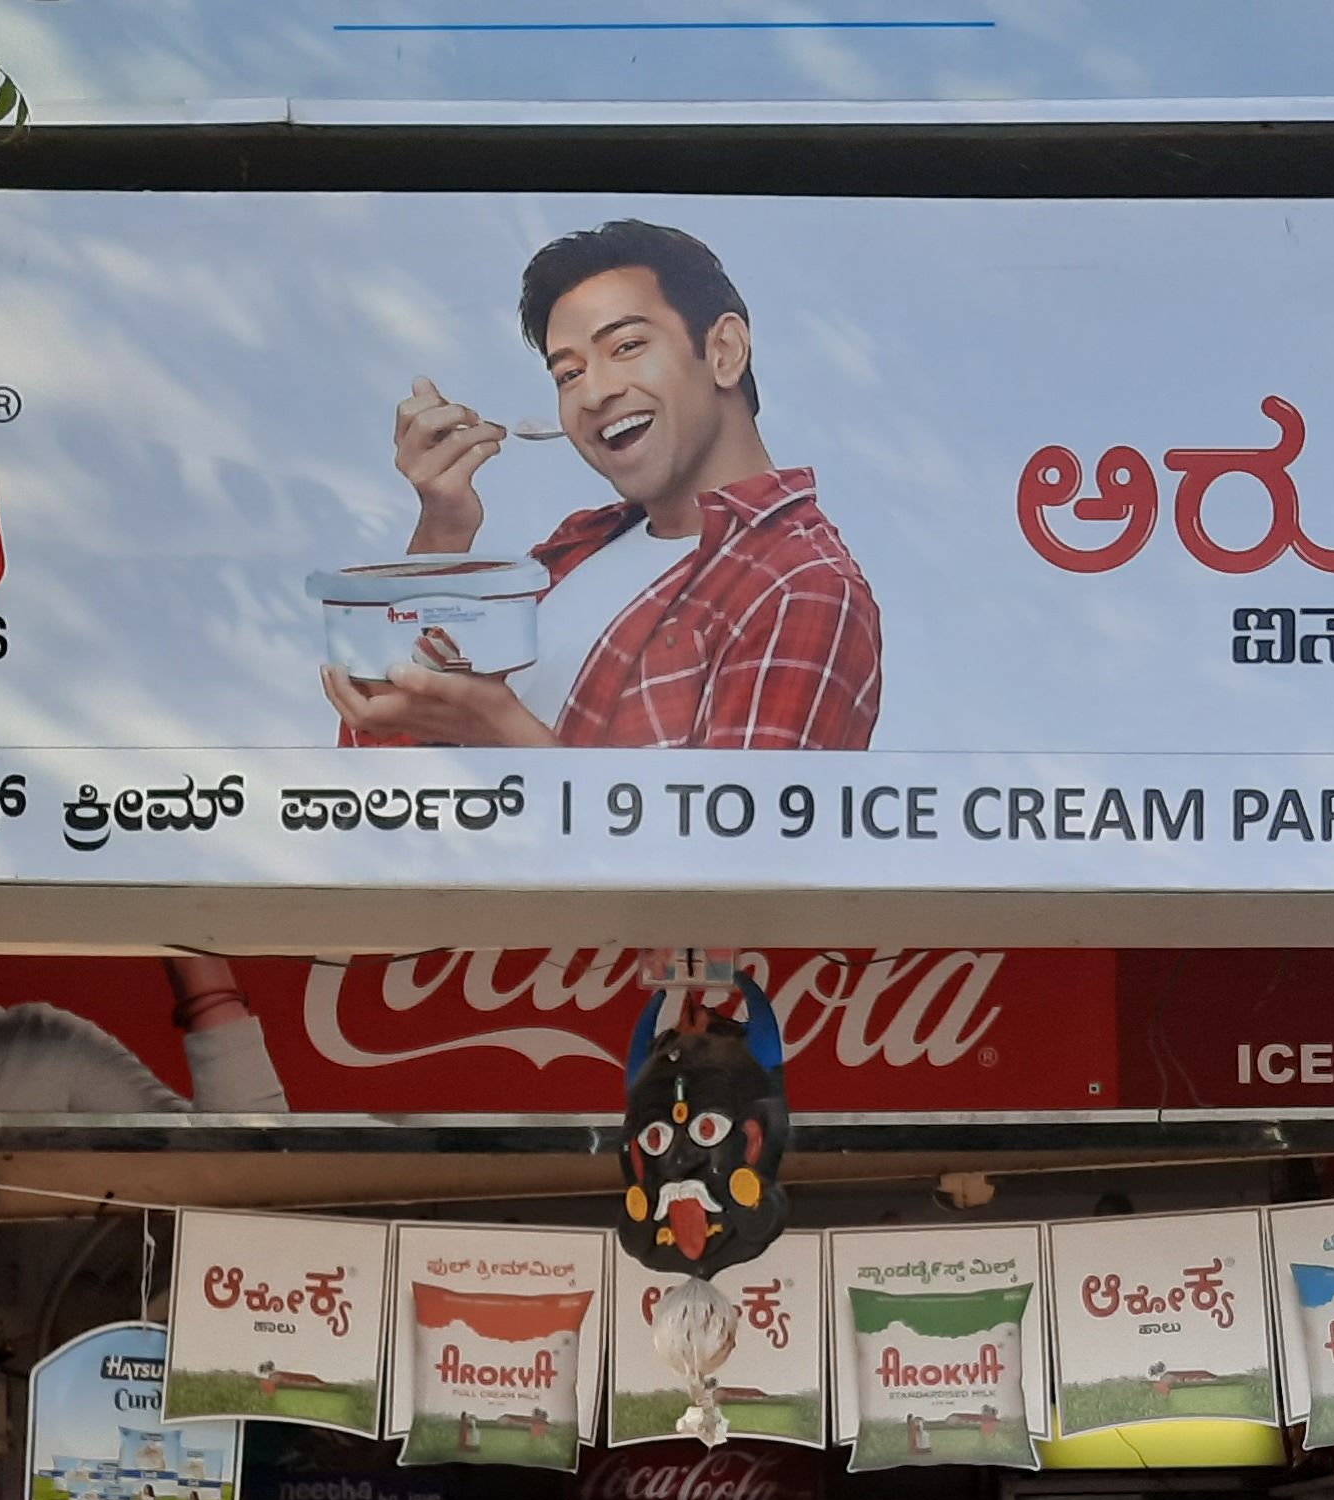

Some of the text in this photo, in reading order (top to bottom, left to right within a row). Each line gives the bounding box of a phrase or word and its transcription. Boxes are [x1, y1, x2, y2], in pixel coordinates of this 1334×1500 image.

[62, 774, 248, 852] ಕ್ರೀಮ್
[607, 783, 643, 837] 9
[675, 784, 755, 838] TO
[779, 785, 815, 840] 9
[840, 787, 938, 840] ICE
[961, 787, 1206, 843] CREAM
[1236, 1043, 1334, 1085] ICE
[105, 1354, 165, 1381] HATSU
[114, 1388, 162, 1411] Curd
